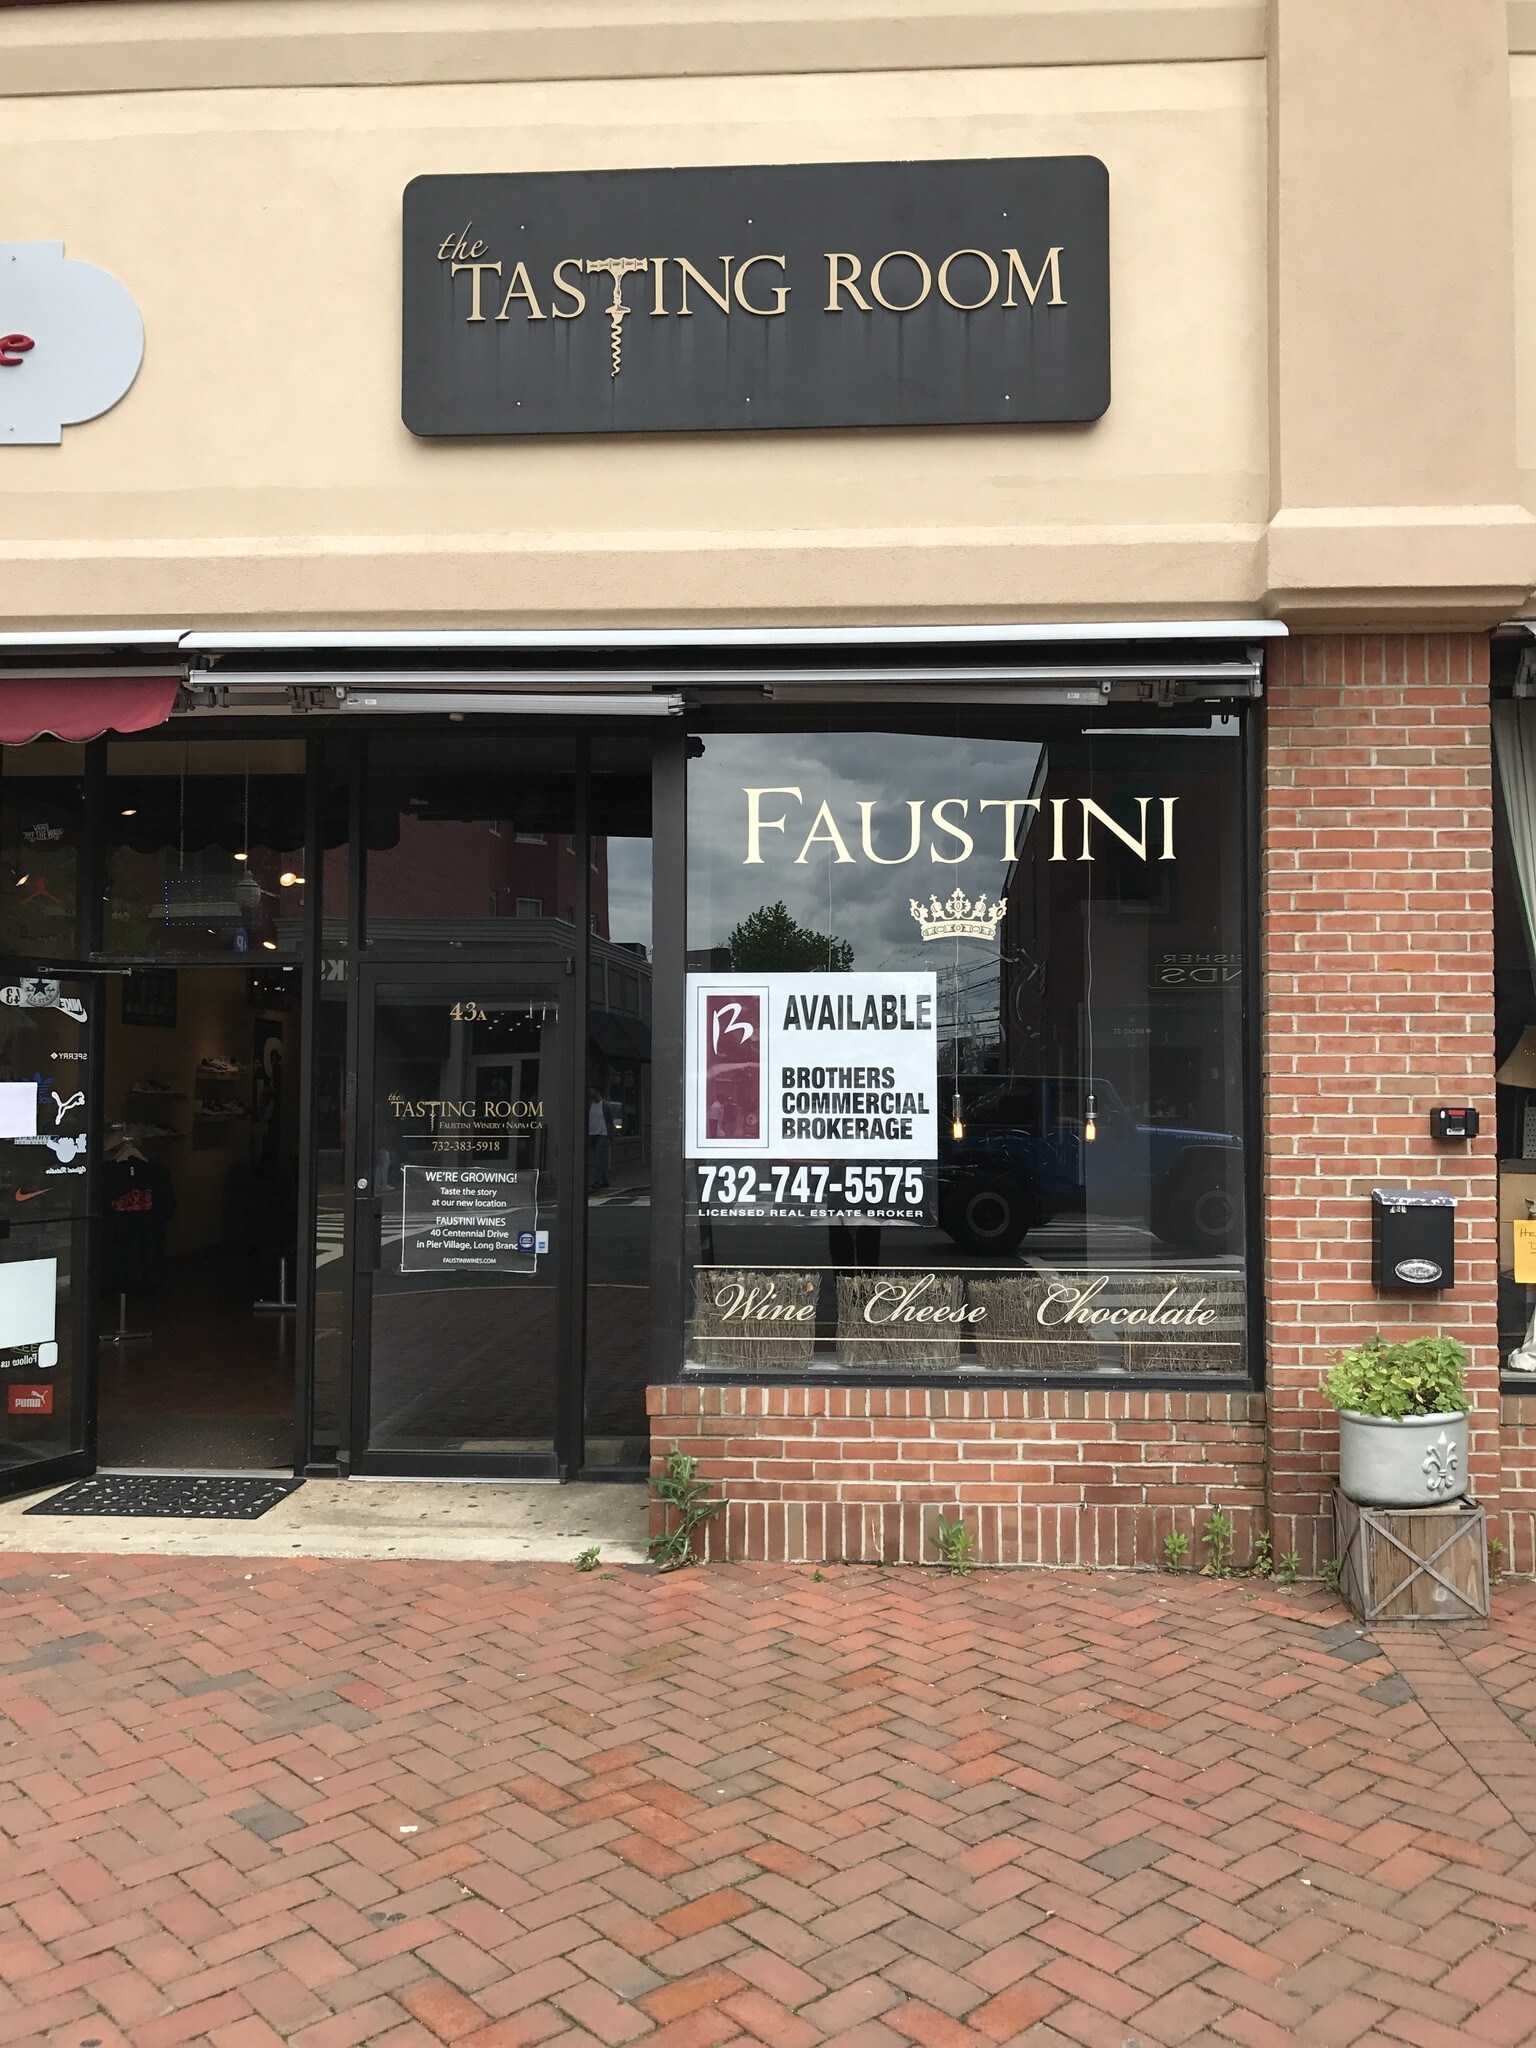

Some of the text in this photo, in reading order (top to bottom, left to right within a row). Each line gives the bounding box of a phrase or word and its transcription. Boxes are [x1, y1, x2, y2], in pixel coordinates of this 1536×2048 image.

[437, 222, 488, 260] the
[451, 247, 1067, 377] TASTING ROOM
[741, 786, 1180, 865] FAUSTINI
[449, 1001, 488, 1021] 43A
[783, 994, 932, 1030] AVAILABLE
[782, 1067, 895, 1088] BROTHERS
[782, 1092, 930, 1114] COMMERCIAL
[391, 1101, 544, 1131] TASTING ROOM
[439, 1121, 543, 1129] FAUSTINI WINERY NAPA CA
[782, 1117, 913, 1139] BROKERAGE
[432, 1141, 500, 1151] 732-383-5918
[425, 1172, 518, 1183] WE'RE GROWING!
[698, 1165, 924, 1203] 732-747-5575
[440, 1187, 497, 1197] Taste the story
[475, 1199, 507, 1207] location
[436, 1217, 506, 1226] FAUSTINI WINES
[698, 1209, 923, 1218] LICENSED REAL ESTATE BROKER
[442, 1229, 486, 1238] Centennial
[487, 1230, 510, 1238] Drive
[427, 1241, 442, 1249] Pier
[443, 1241, 472, 1250] Village,
[473, 1241, 494, 1251] Long
[496, 1241, 518, 1250] Branc
[714, 1273, 1218, 1326] Wine Cheese Chocolate
[15, 1398, 41, 1408] PUMA
